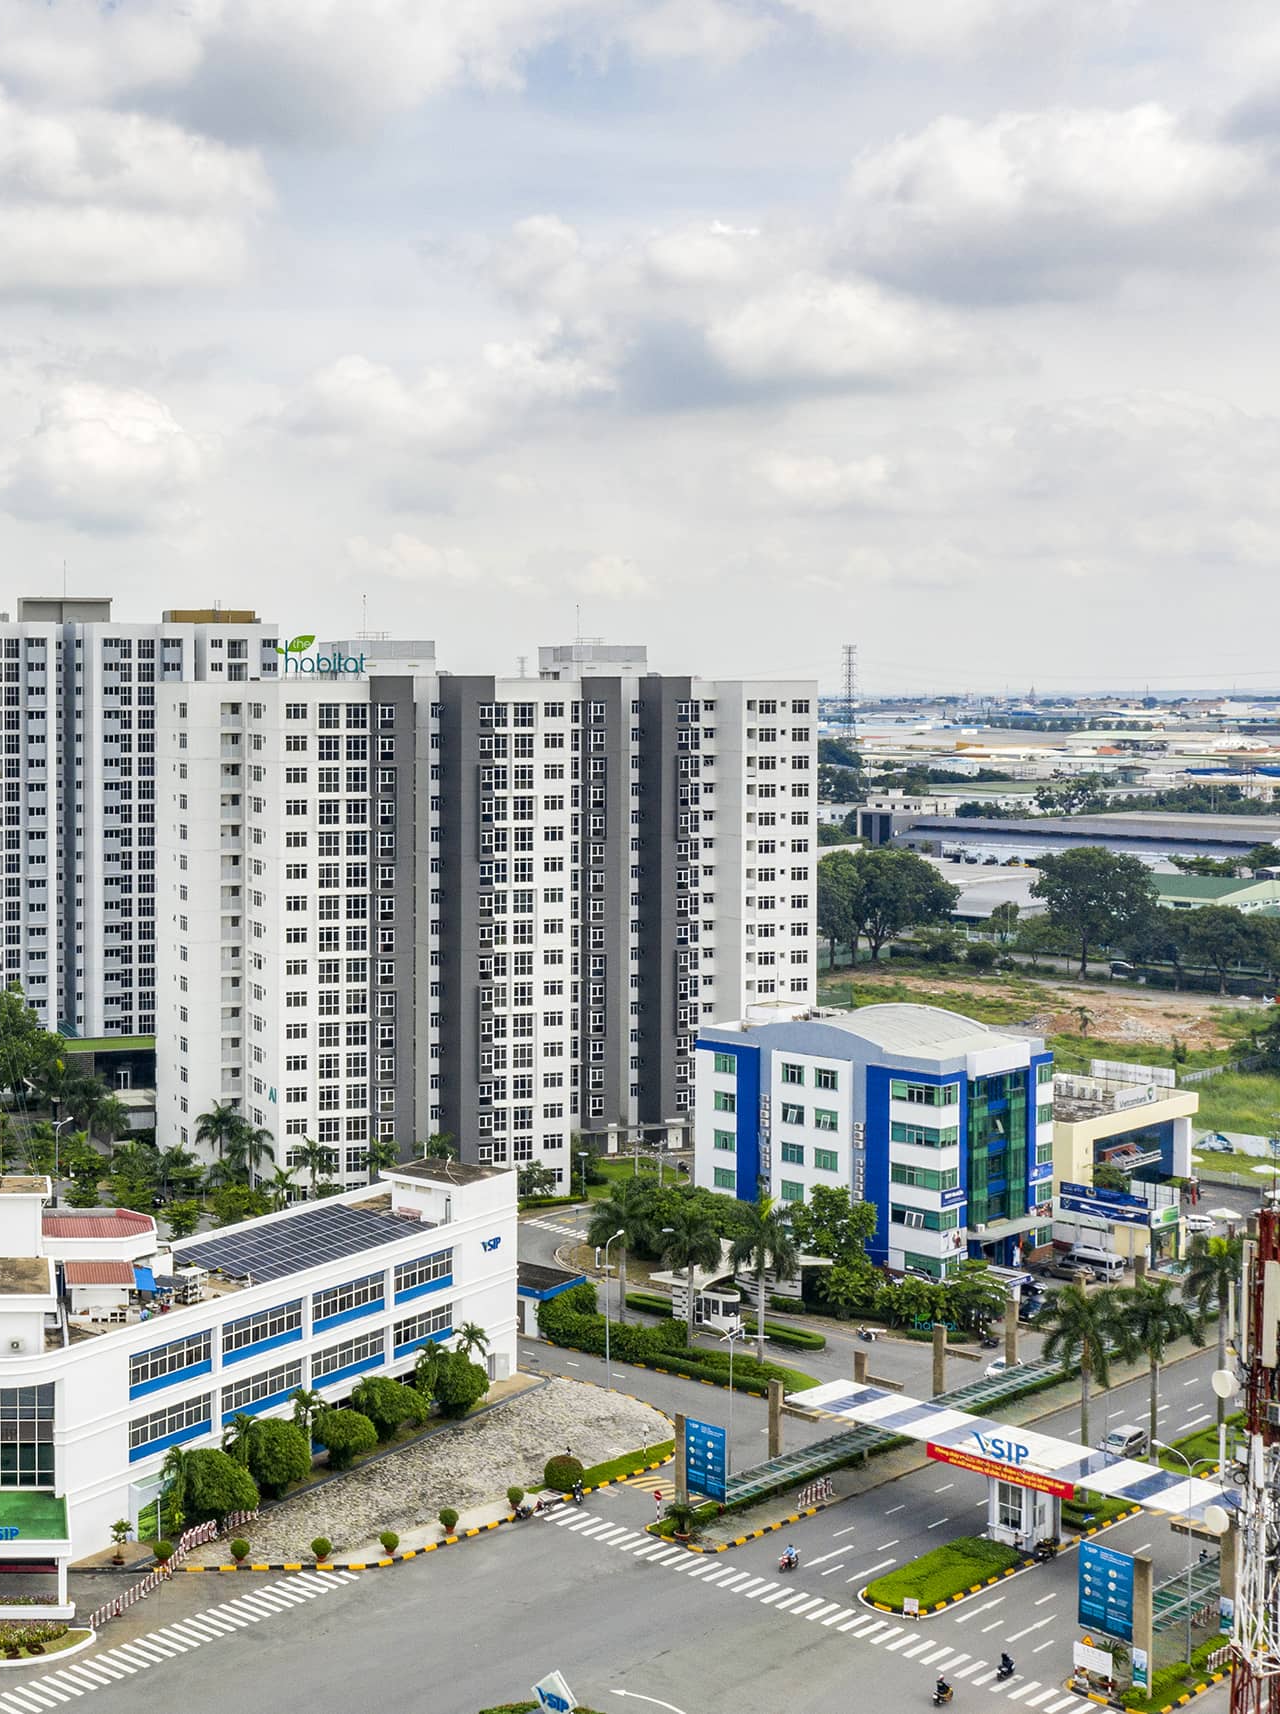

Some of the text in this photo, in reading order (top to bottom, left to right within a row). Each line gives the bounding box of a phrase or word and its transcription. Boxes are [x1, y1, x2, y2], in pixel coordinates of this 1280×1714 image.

[284, 639, 367, 674] habitat
[292, 639, 312, 650] the
[480, 1236, 501, 1253] VSIP
[969, 1430, 1030, 1465] VSIP
